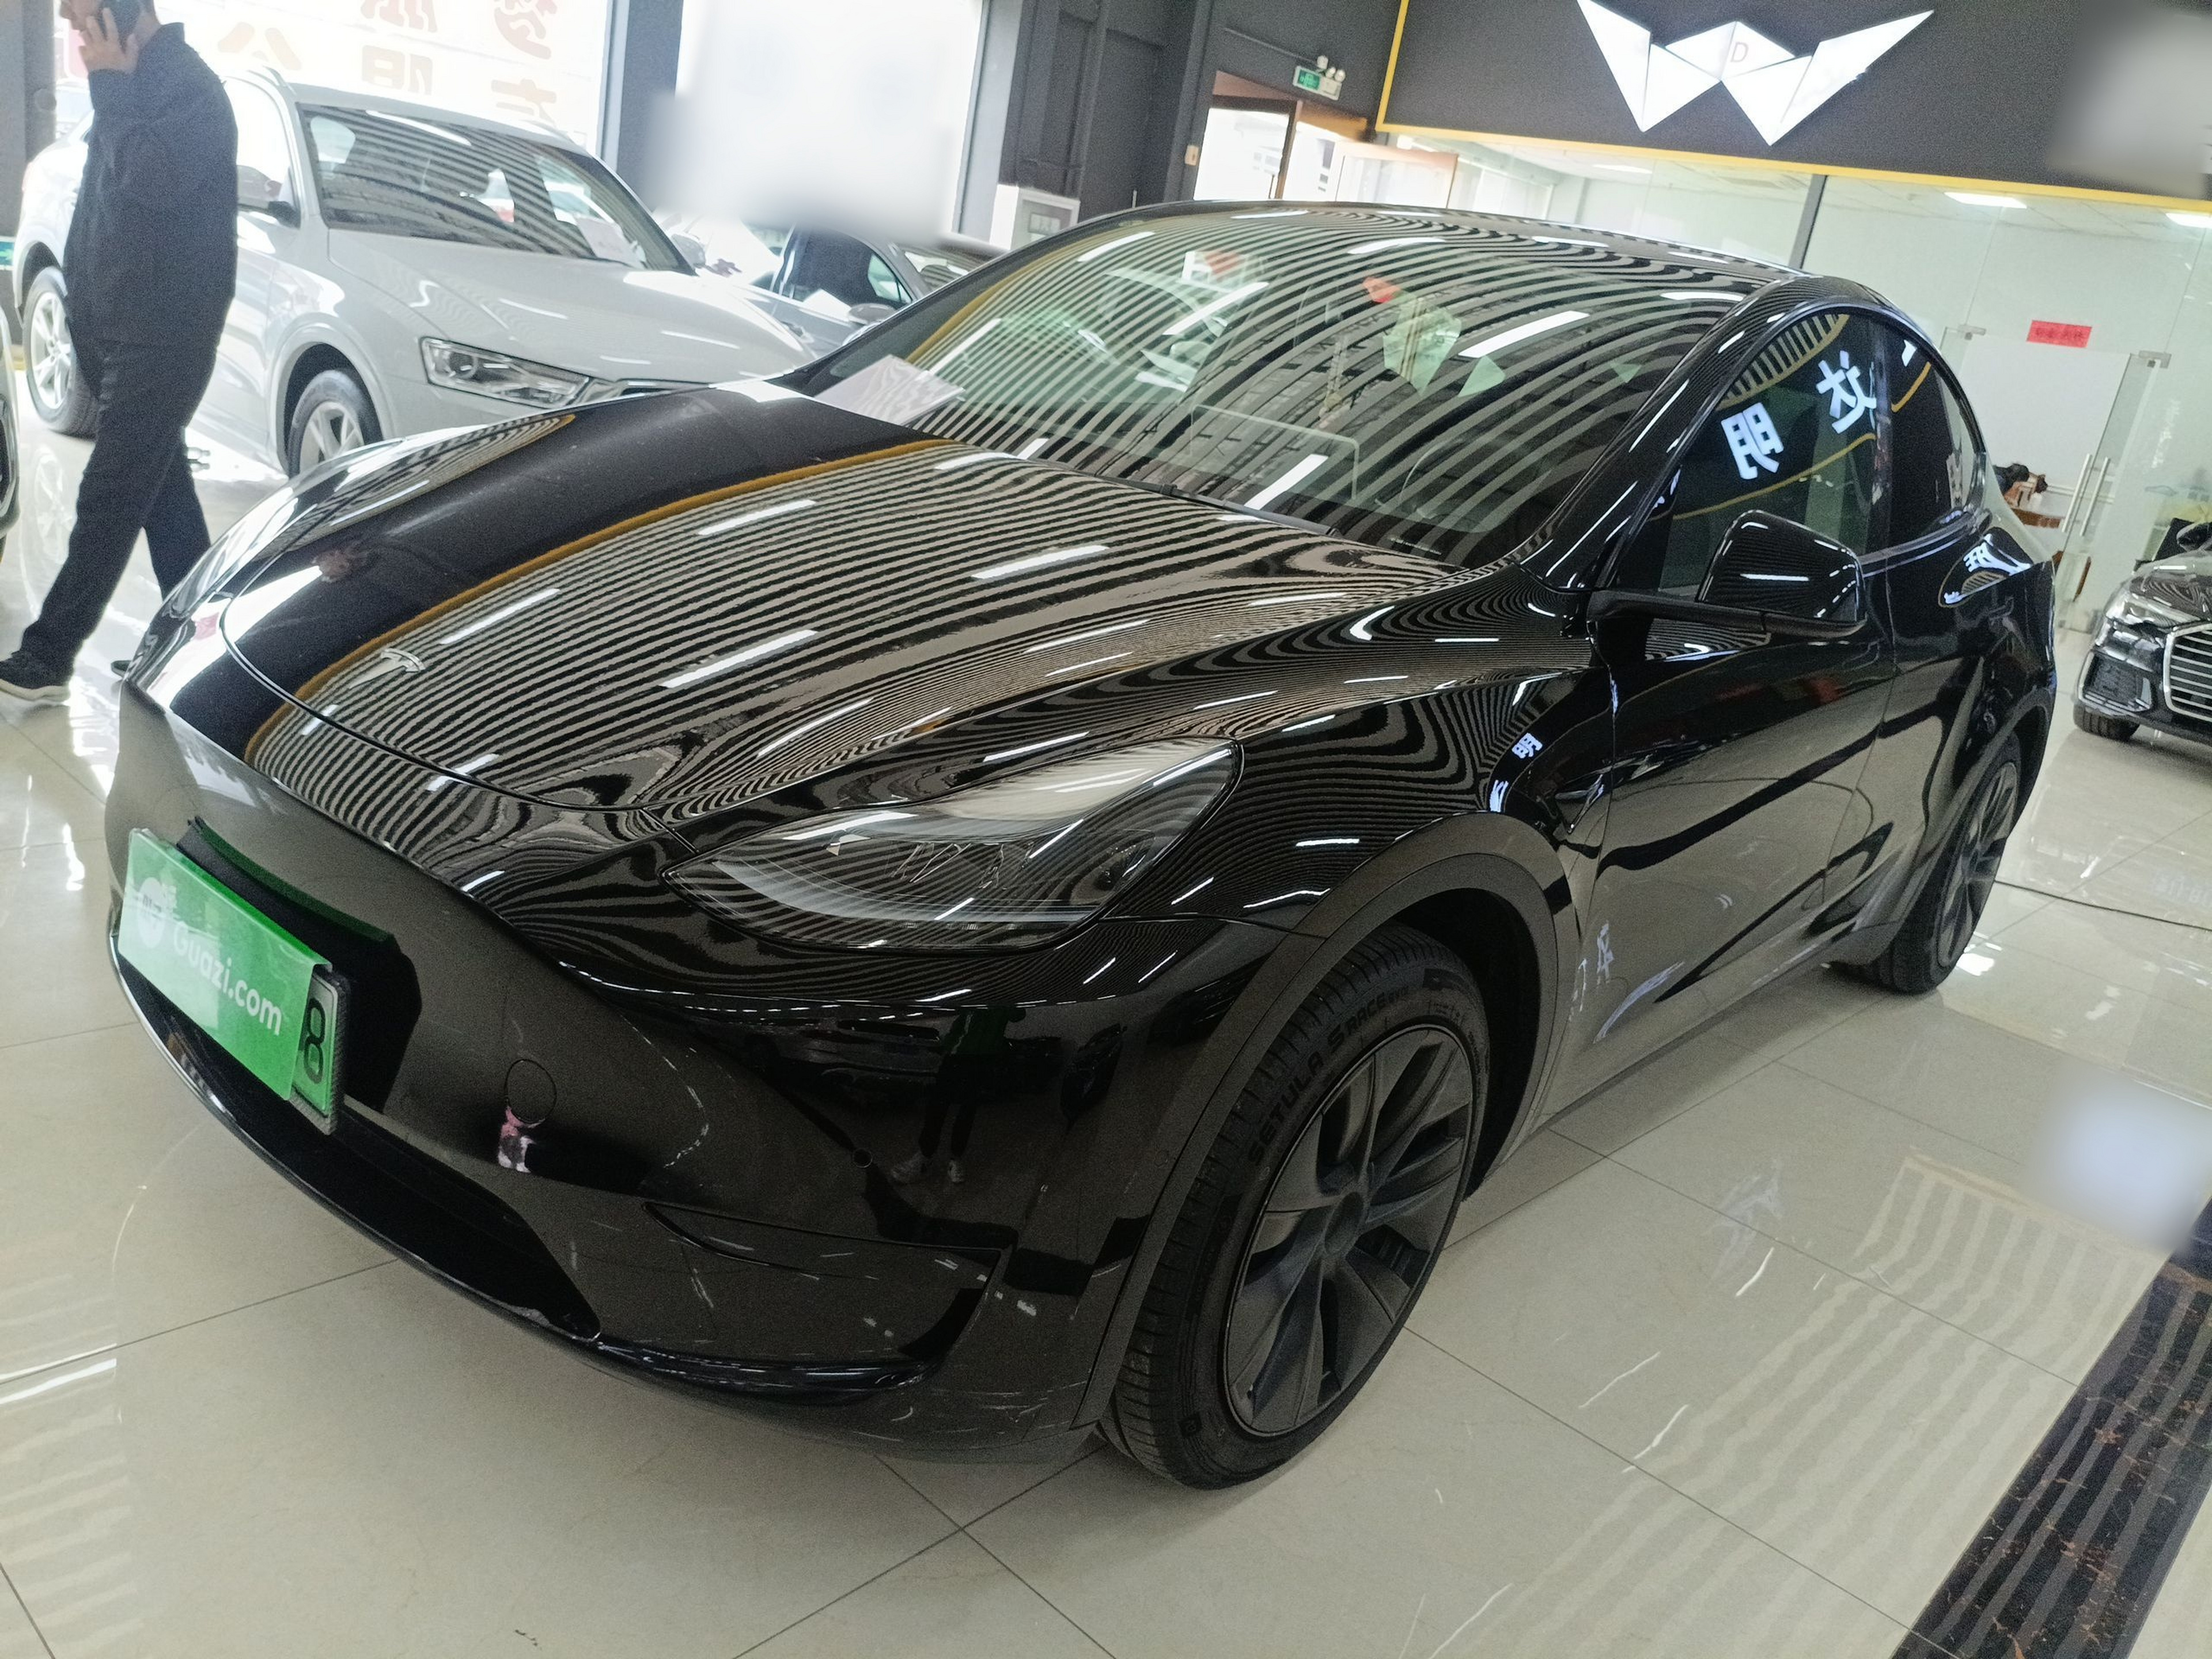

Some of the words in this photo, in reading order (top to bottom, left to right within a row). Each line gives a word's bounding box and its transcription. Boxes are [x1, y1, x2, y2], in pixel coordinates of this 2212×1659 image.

[173, 925, 282, 1036] Guazi.com
[303, 998, 327, 1084] 8
[1248, 1051, 1325, 1166] SETULA
